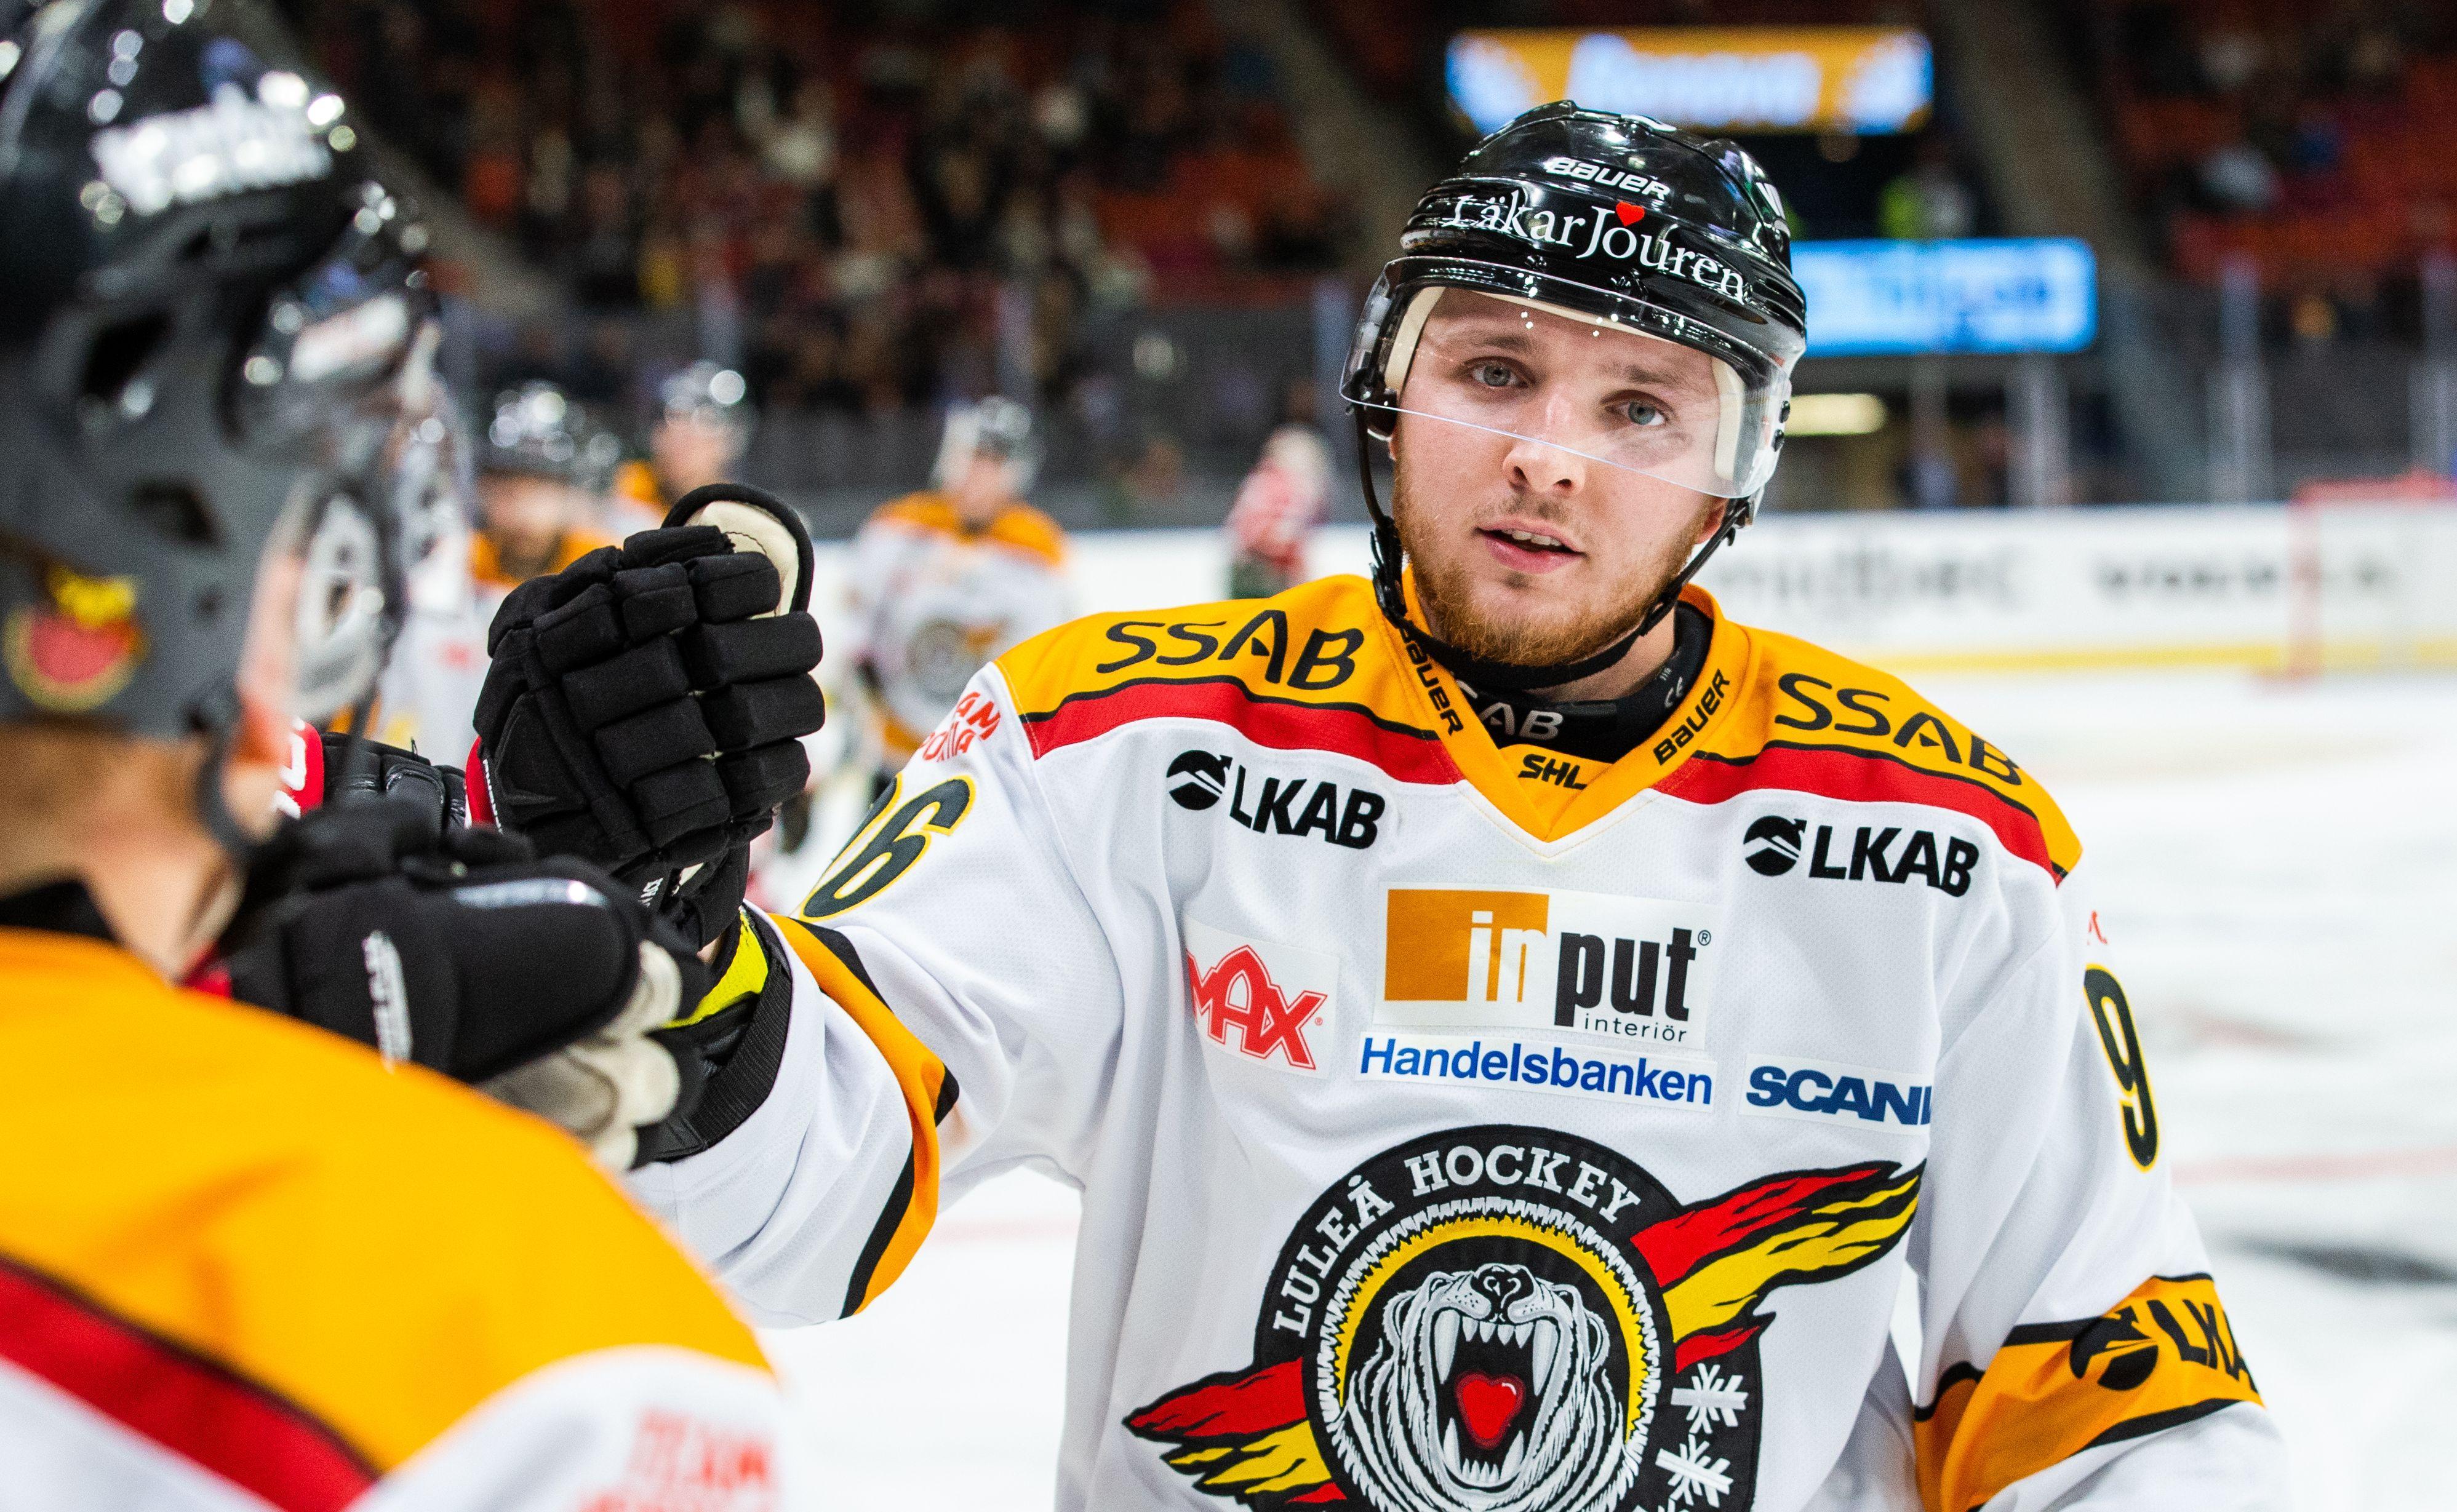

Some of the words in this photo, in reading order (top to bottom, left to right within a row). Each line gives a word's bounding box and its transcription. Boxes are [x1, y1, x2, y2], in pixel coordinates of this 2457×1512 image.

[1545, 156, 1671, 200] BAUER
[1441, 189, 1748, 306] LäkarJouren
[1096, 610, 1364, 690] SSAB
[1456, 679, 1564, 740] AB
[1653, 668, 1730, 766] BAUER
[1775, 672, 2023, 786] SSAB
[1230, 765, 1386, 849] LKAB
[1518, 754, 1588, 790] SHL
[1808, 824, 1980, 897] LKAB
[1584, 1013, 1688, 1043] interiör
[2083, 963, 2160, 1171] 9
[1360, 1037, 1712, 1105] Handelsbanken
[1272, 1174, 1395, 1339] LULEÅ
[1404, 1144, 1642, 1224] HOCKEY
